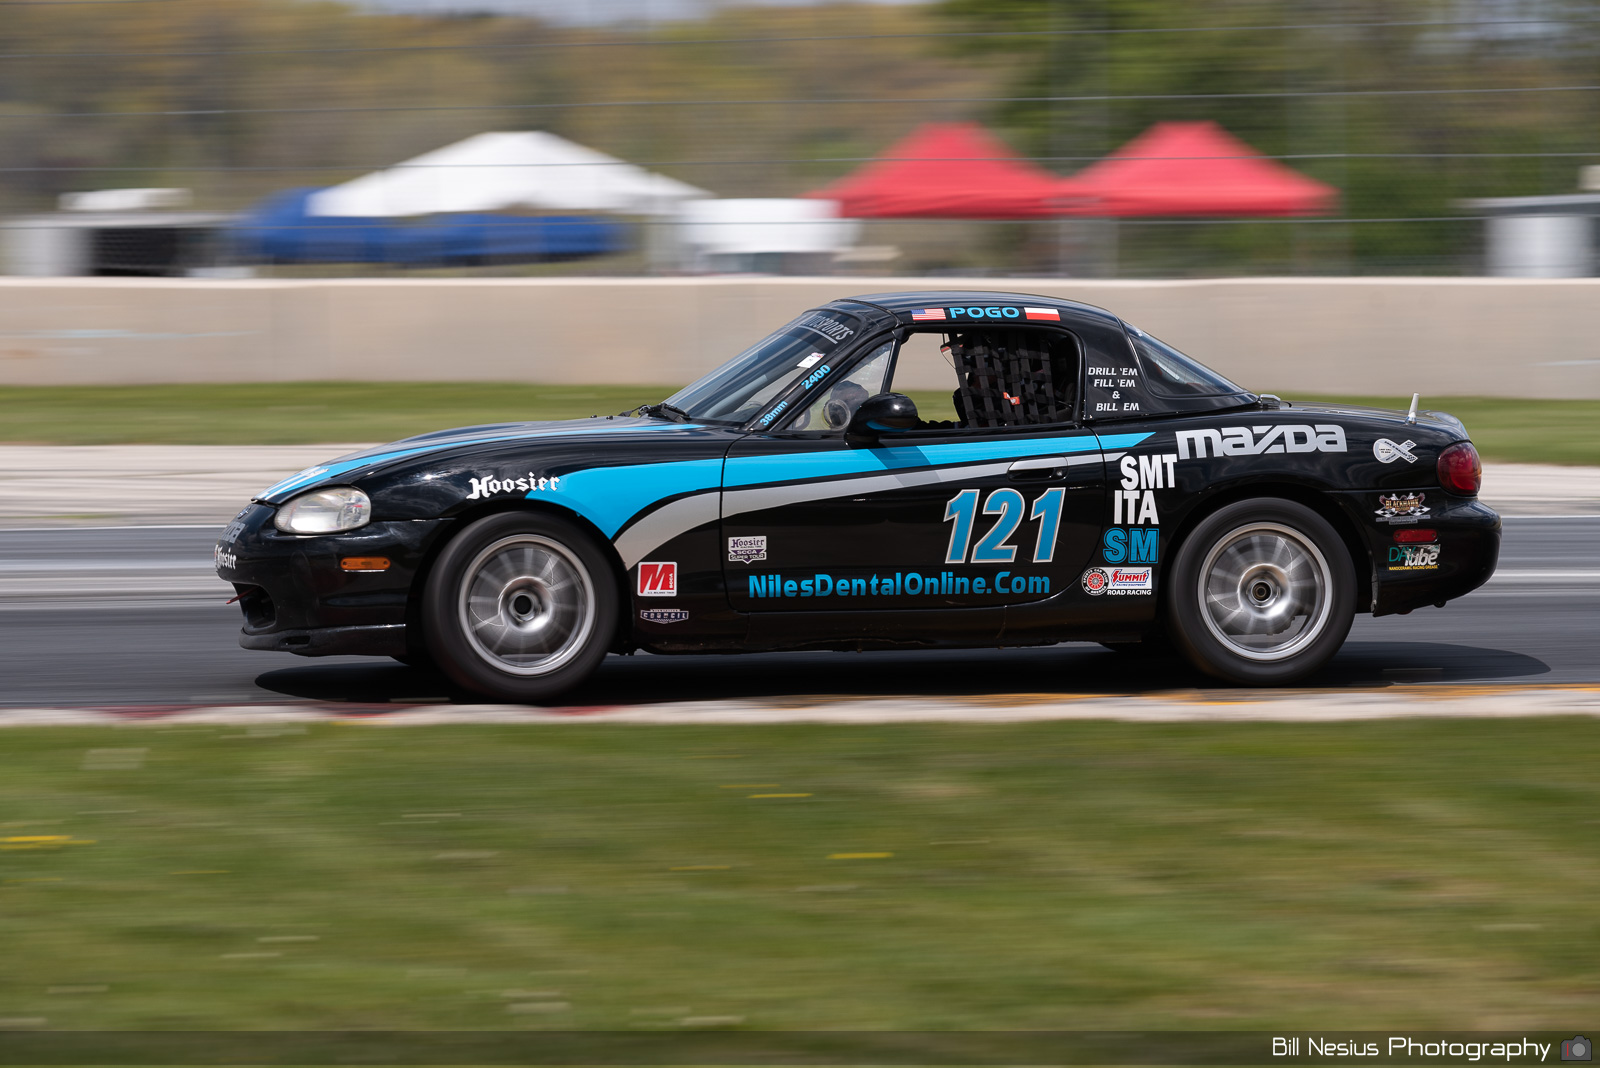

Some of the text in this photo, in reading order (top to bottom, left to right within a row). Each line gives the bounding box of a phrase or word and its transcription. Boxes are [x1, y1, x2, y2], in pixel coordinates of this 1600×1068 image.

[949, 307, 1020, 319] POGO
[801, 364, 831, 390] 2400
[1088, 367, 1117, 376] DRILL
[1093, 379, 1114, 388] FILL
[1095, 403, 1140, 411] BILL EM
[1111, 391, 1121, 399] &
[760, 400, 788, 426] 38mm
[1120, 454, 1178, 490] SMT
[466, 472, 560, 500] Hoosier
[1113, 490, 1160, 525] ITA
[943, 487, 1067, 564] 121
[731, 537, 765, 549] Hoosier
[1103, 527, 1160, 564] SM
[748, 571, 1051, 599] NilesDentalOnline.Com
